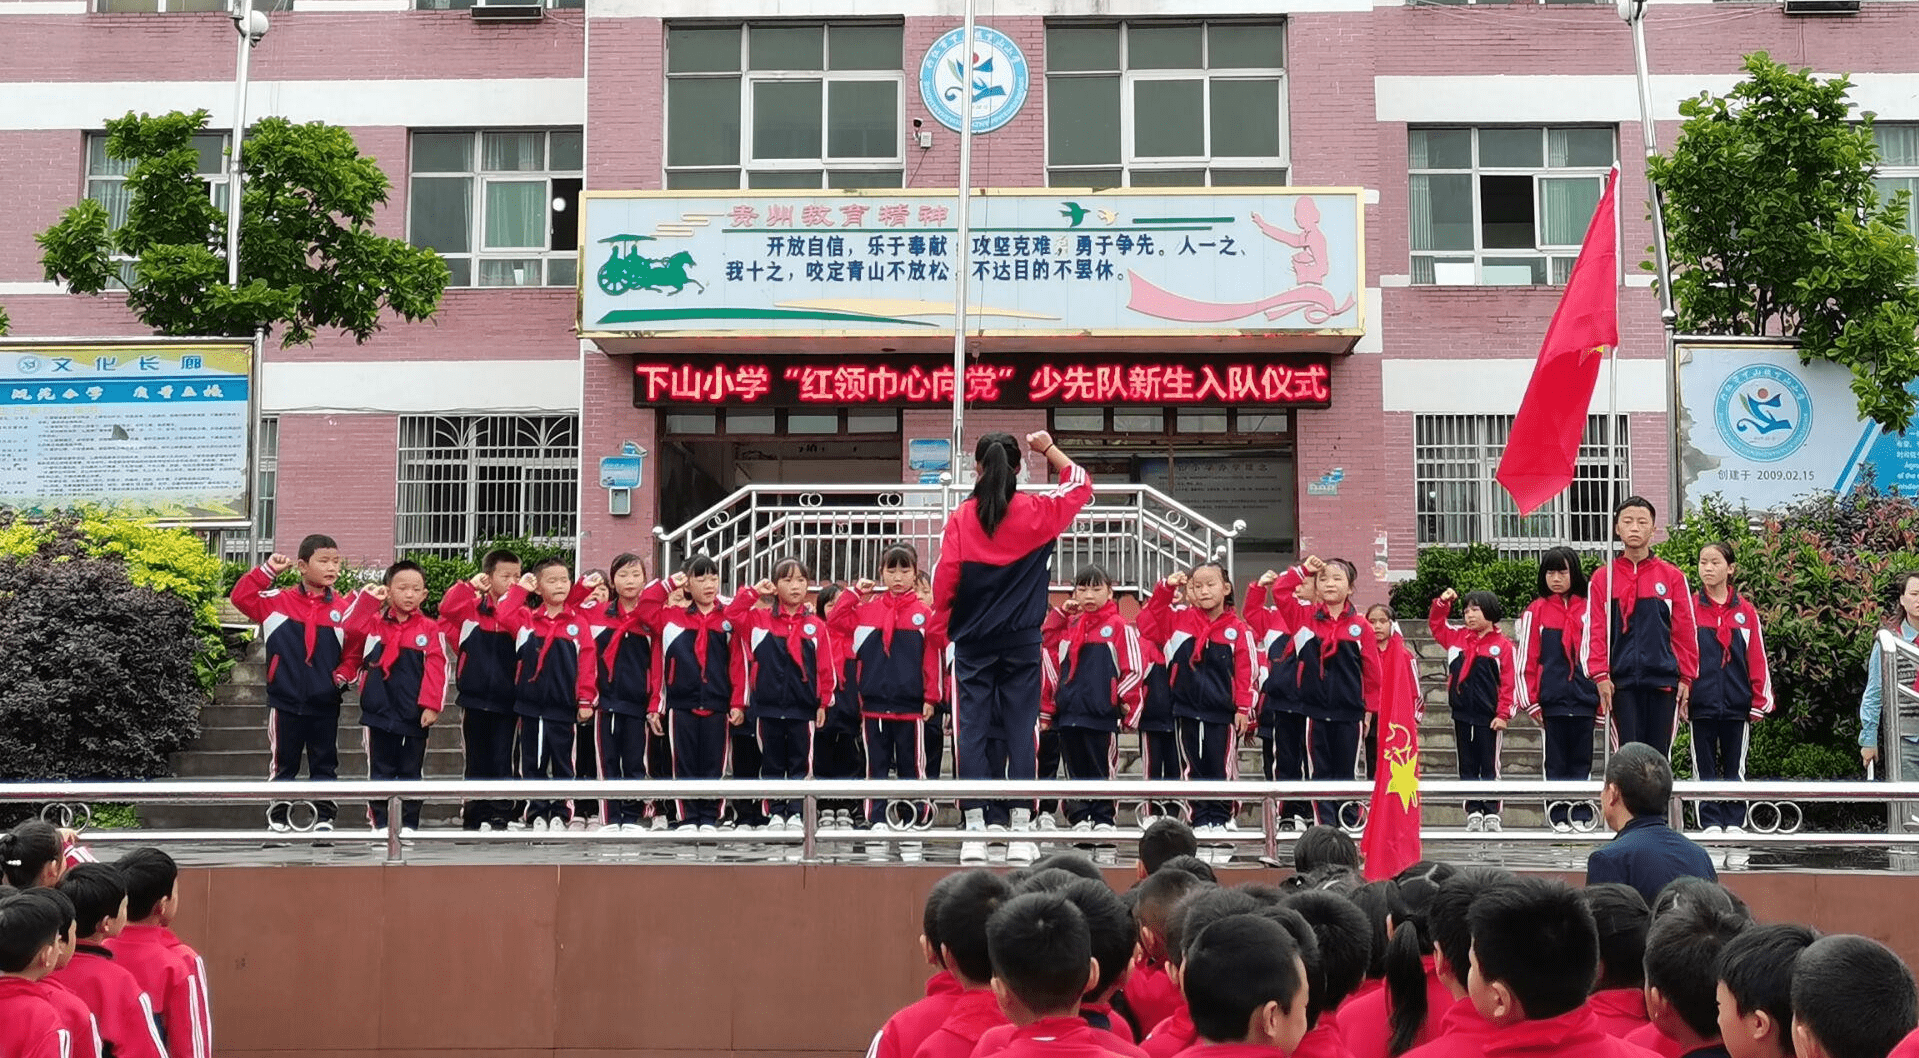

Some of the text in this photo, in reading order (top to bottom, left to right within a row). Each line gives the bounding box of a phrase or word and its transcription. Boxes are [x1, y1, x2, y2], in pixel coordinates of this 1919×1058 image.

[729, 204, 949, 227] 贵州教育精神
[51, 355, 202, 372] 文化长廊
[1718, 469, 1815, 481] 创建于 2009.02.15
